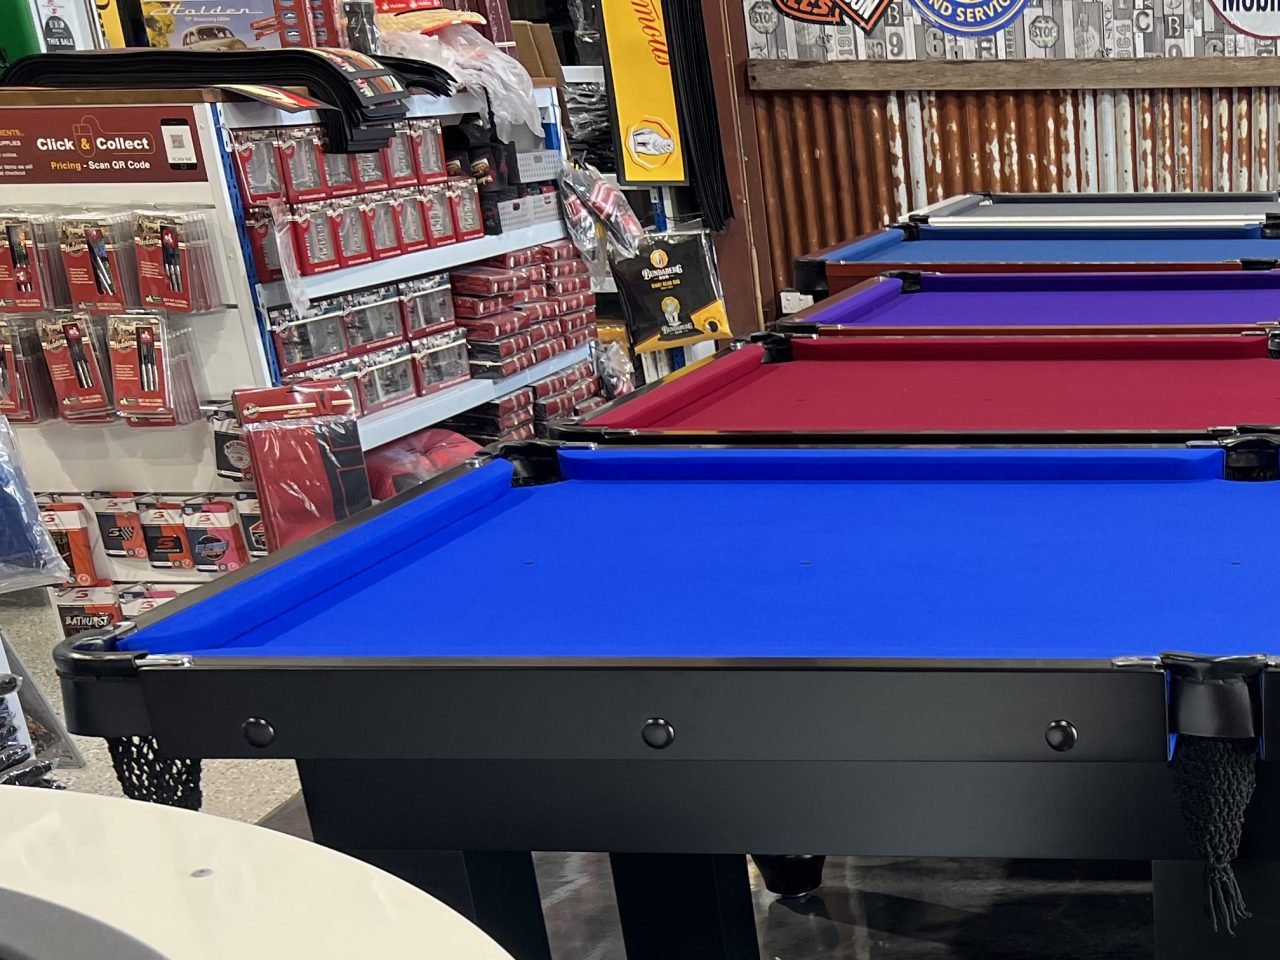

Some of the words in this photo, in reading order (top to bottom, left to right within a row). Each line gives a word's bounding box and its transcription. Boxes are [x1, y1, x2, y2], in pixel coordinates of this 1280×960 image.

[150, 3, 264, 15] Holden
[37, 138, 75, 151] Click
[81, 138, 90, 150] &
[96, 137, 149, 150] Collect
[51, 161, 81, 171] Pricing
[88, 161, 110, 169] Scan
[112, 160, 125, 169] QR
[130, 160, 150, 169] Code
[64, 615, 109, 627] BATHURST
